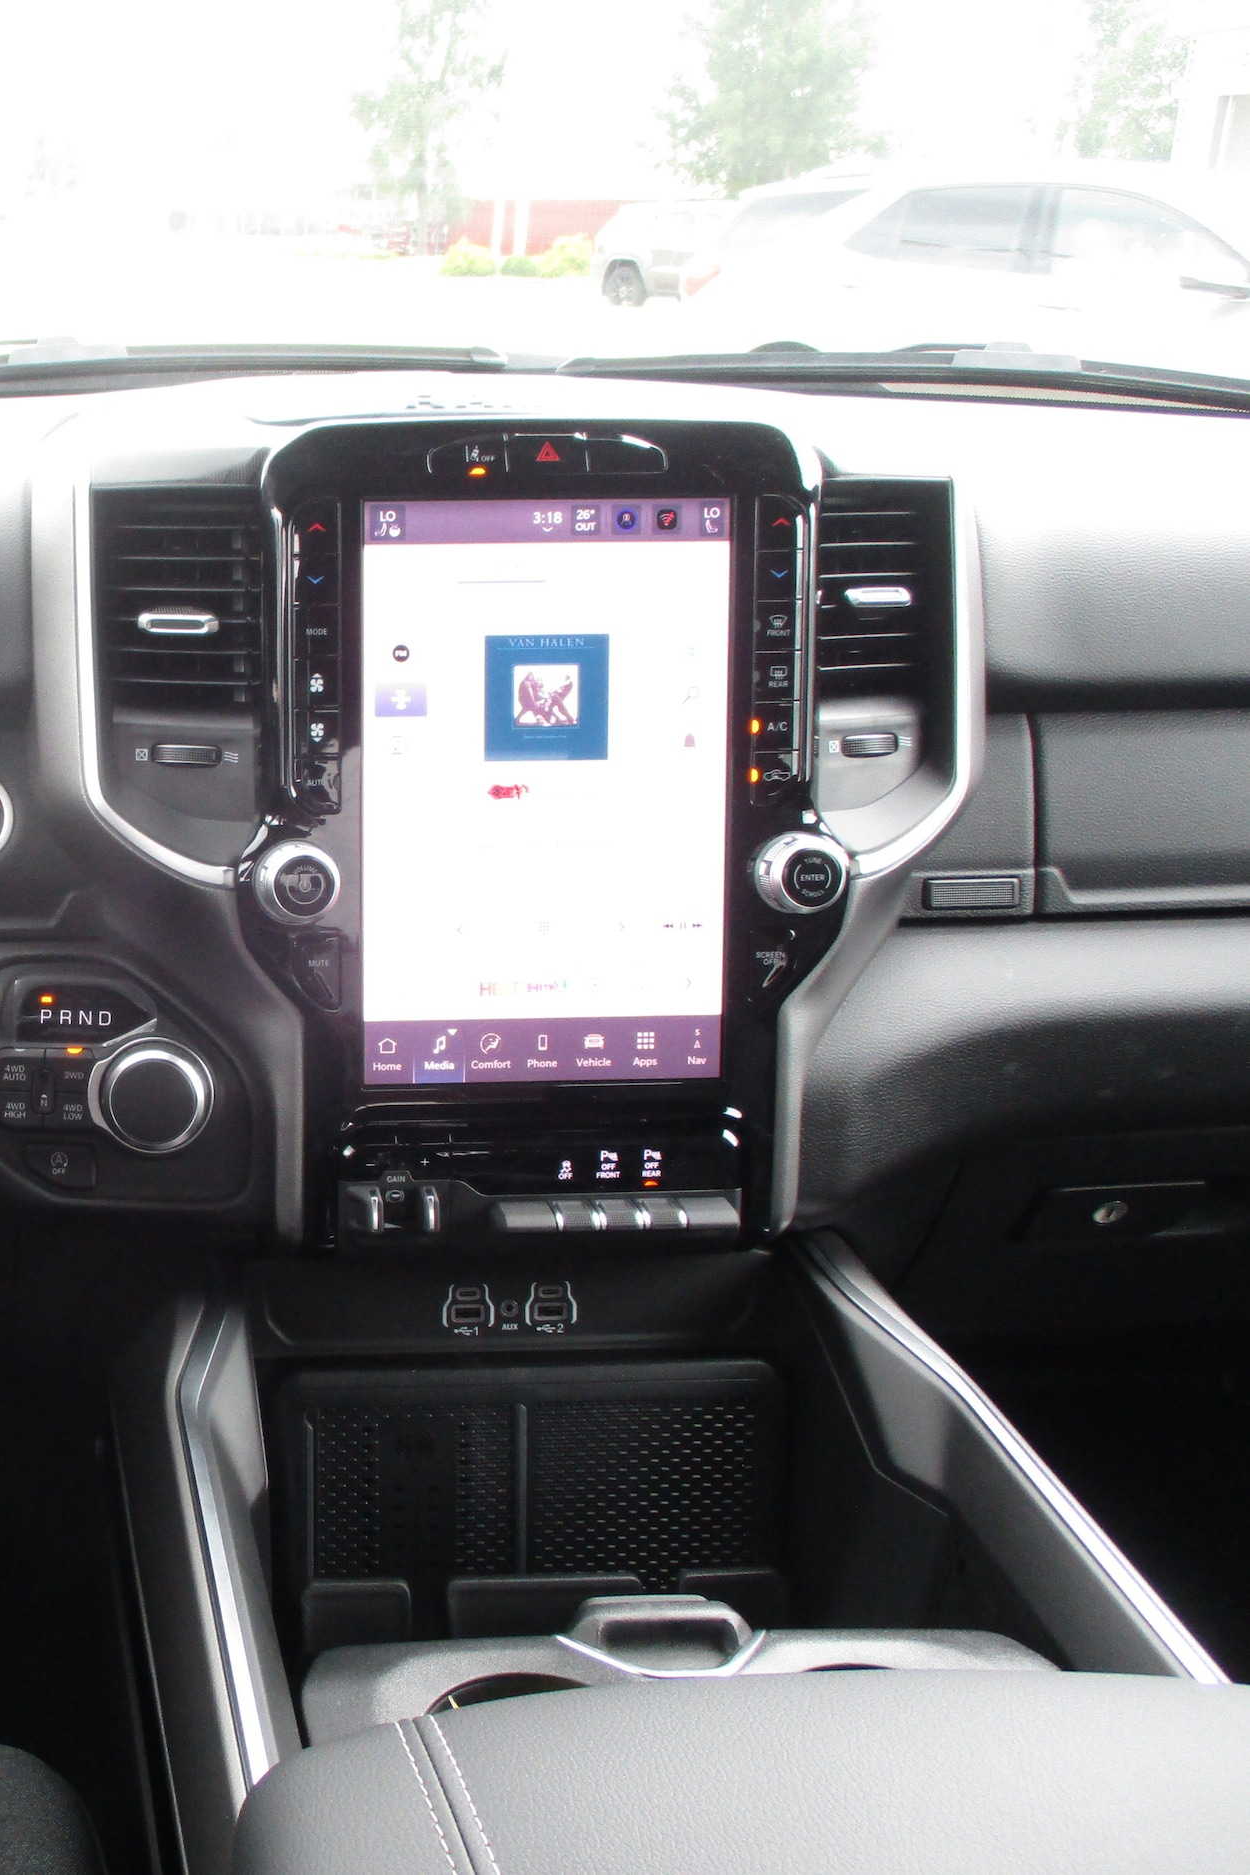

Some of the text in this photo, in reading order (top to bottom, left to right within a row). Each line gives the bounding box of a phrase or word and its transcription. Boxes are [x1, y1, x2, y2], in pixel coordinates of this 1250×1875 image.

[480, 455, 496, 463] OFF
[380, 510, 396, 522] LO
[533, 511, 563, 524] 3:18
[704, 507, 721, 519] LO
[575, 522, 596, 532] OUT
[306, 628, 328, 636] MODE
[766, 629, 791, 637] FRONT
[509, 637, 585, 647] VAN HALEN
[394, 649, 408, 658] FM
[767, 722, 788, 732] A/C
[804, 857, 823, 865] TUNE
[292, 865, 319, 876] VOLUME
[800, 873, 825, 882] ENTER
[755, 951, 786, 959] SCREEN
[308, 959, 330, 968] MUTE
[471, 1060, 511, 1069] Comfort
[527, 1059, 558, 1068] Phone
[576, 1057, 612, 1067] Vehicle
[633, 1057, 658, 1068] Apps
[687, 1056, 707, 1065] Nav
[4, 1064, 25, 1072] 4WD
[373, 1062, 402, 1071] Home
[424, 1061, 455, 1070] Media
[3, 1073, 26, 1081] AUTO
[64, 1071, 84, 1080] 2WD
[6, 1102, 25, 1110] 4WD
[40, 1099, 48, 1107] N
[62, 1104, 83, 1112] 4WD
[4, 1111, 26, 1119] HIGH
[63, 1113, 83, 1121] LOW
[644, 1161, 660, 1169] OFF
[557, 1172, 574, 1180] OFF
[596, 1171, 621, 1179] FRONT
[641, 1170, 662, 1178] REAR
[386, 1175, 406, 1183] GAIN
[501, 1323, 519, 1331] AUX
[556, 1323, 564, 1334] 2
